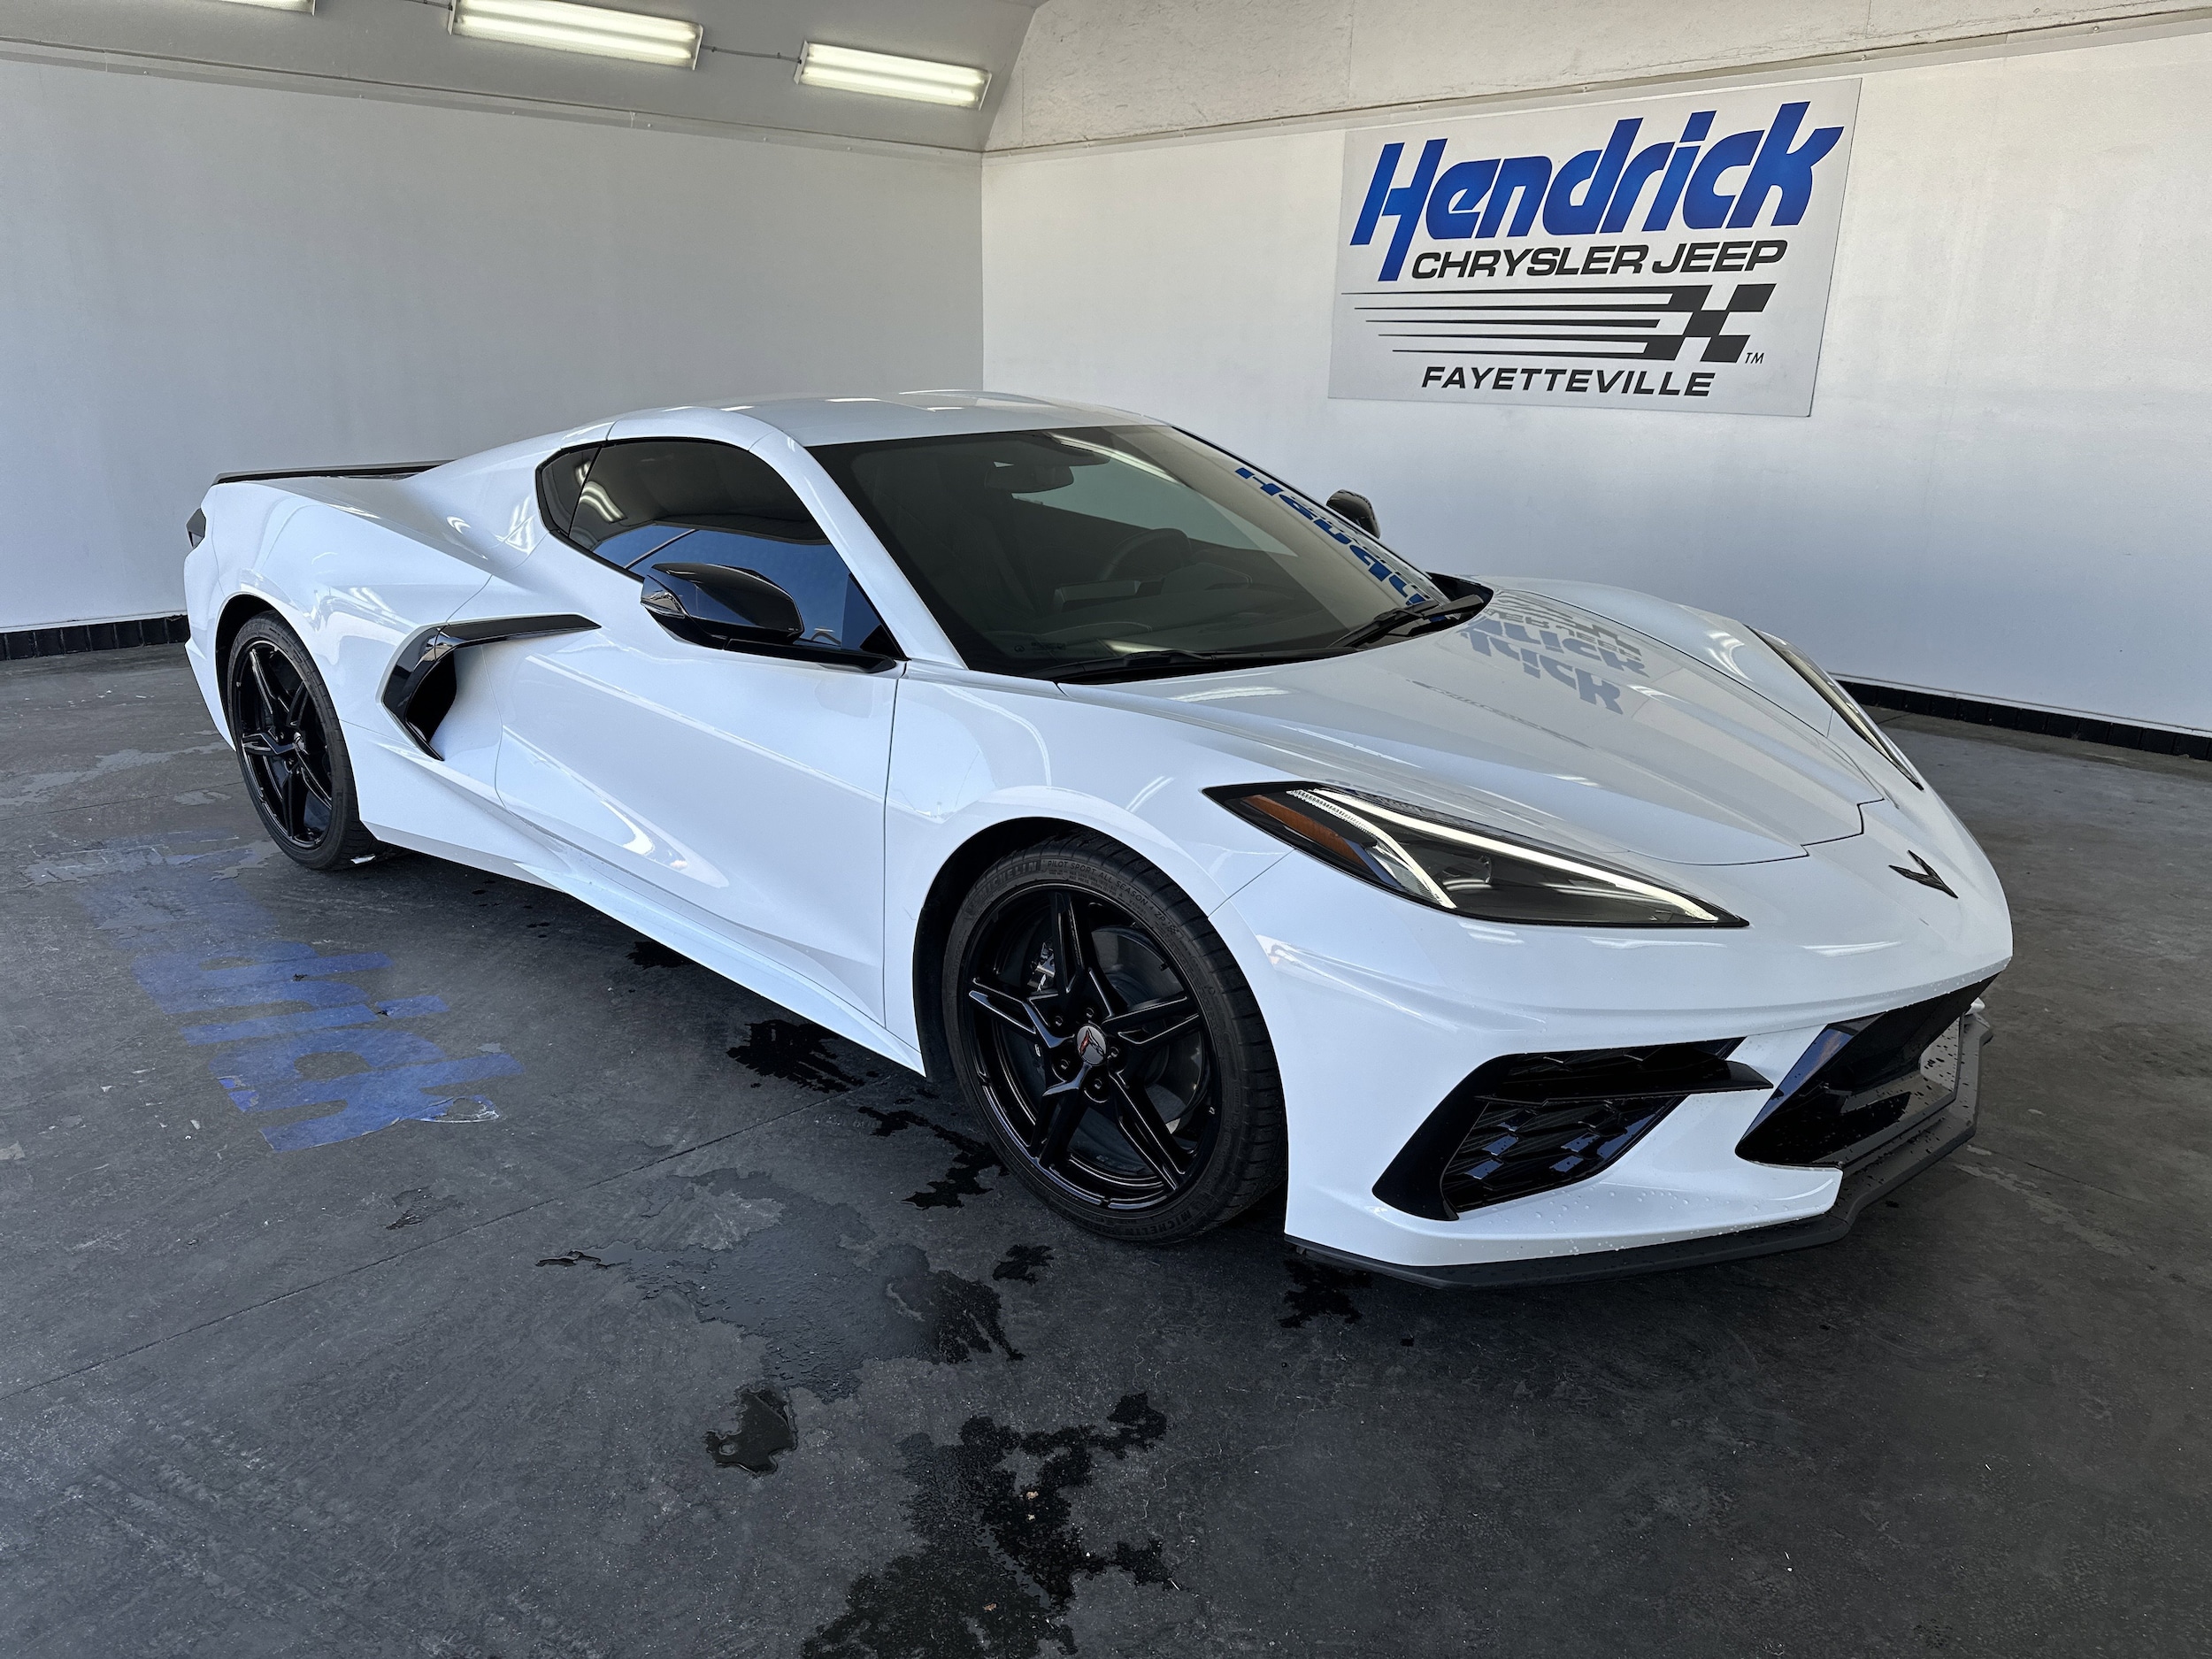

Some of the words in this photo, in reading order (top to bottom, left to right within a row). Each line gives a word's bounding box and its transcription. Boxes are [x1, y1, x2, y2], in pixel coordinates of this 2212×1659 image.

[1350, 102, 1844, 281] Hendrick
[1412, 244, 1649, 279] CHRYSLER
[1652, 240, 1787, 273] JEEP
[1746, 353, 1764, 364] TM
[1421, 366, 1716, 396] FAYETTEVILLE
[1070, 862, 1097, 876] SPORT
[1098, 872, 1112, 884] ALL
[1117, 880, 1148, 906] SEASON
